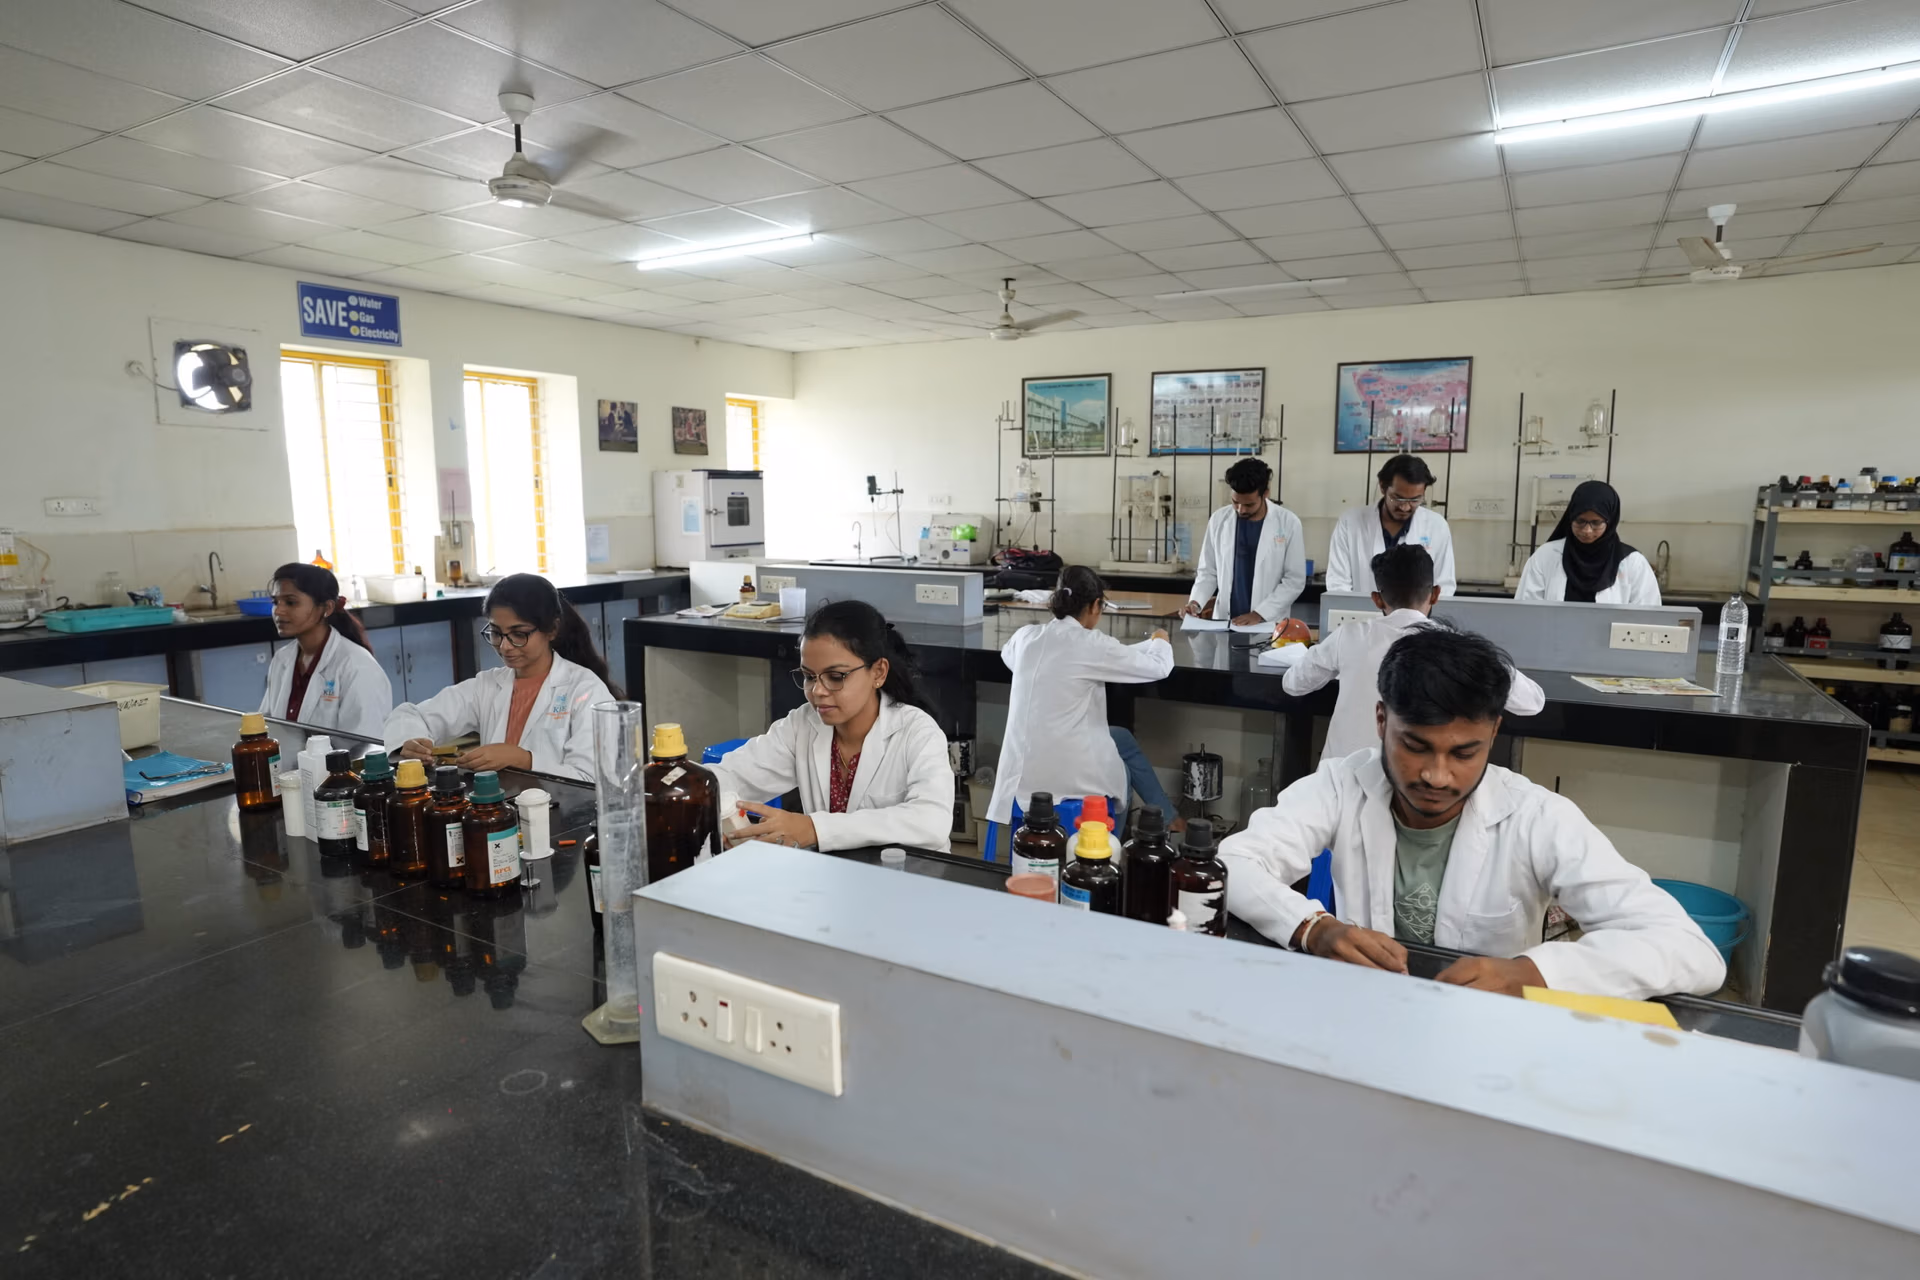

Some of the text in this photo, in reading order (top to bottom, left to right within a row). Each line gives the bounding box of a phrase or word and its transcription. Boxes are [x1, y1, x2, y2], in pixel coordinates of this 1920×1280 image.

[358, 297, 382, 310] Water
[303, 296, 348, 327] SAVE
[359, 311, 375, 324] Gas
[360, 326, 399, 343] Electricity
